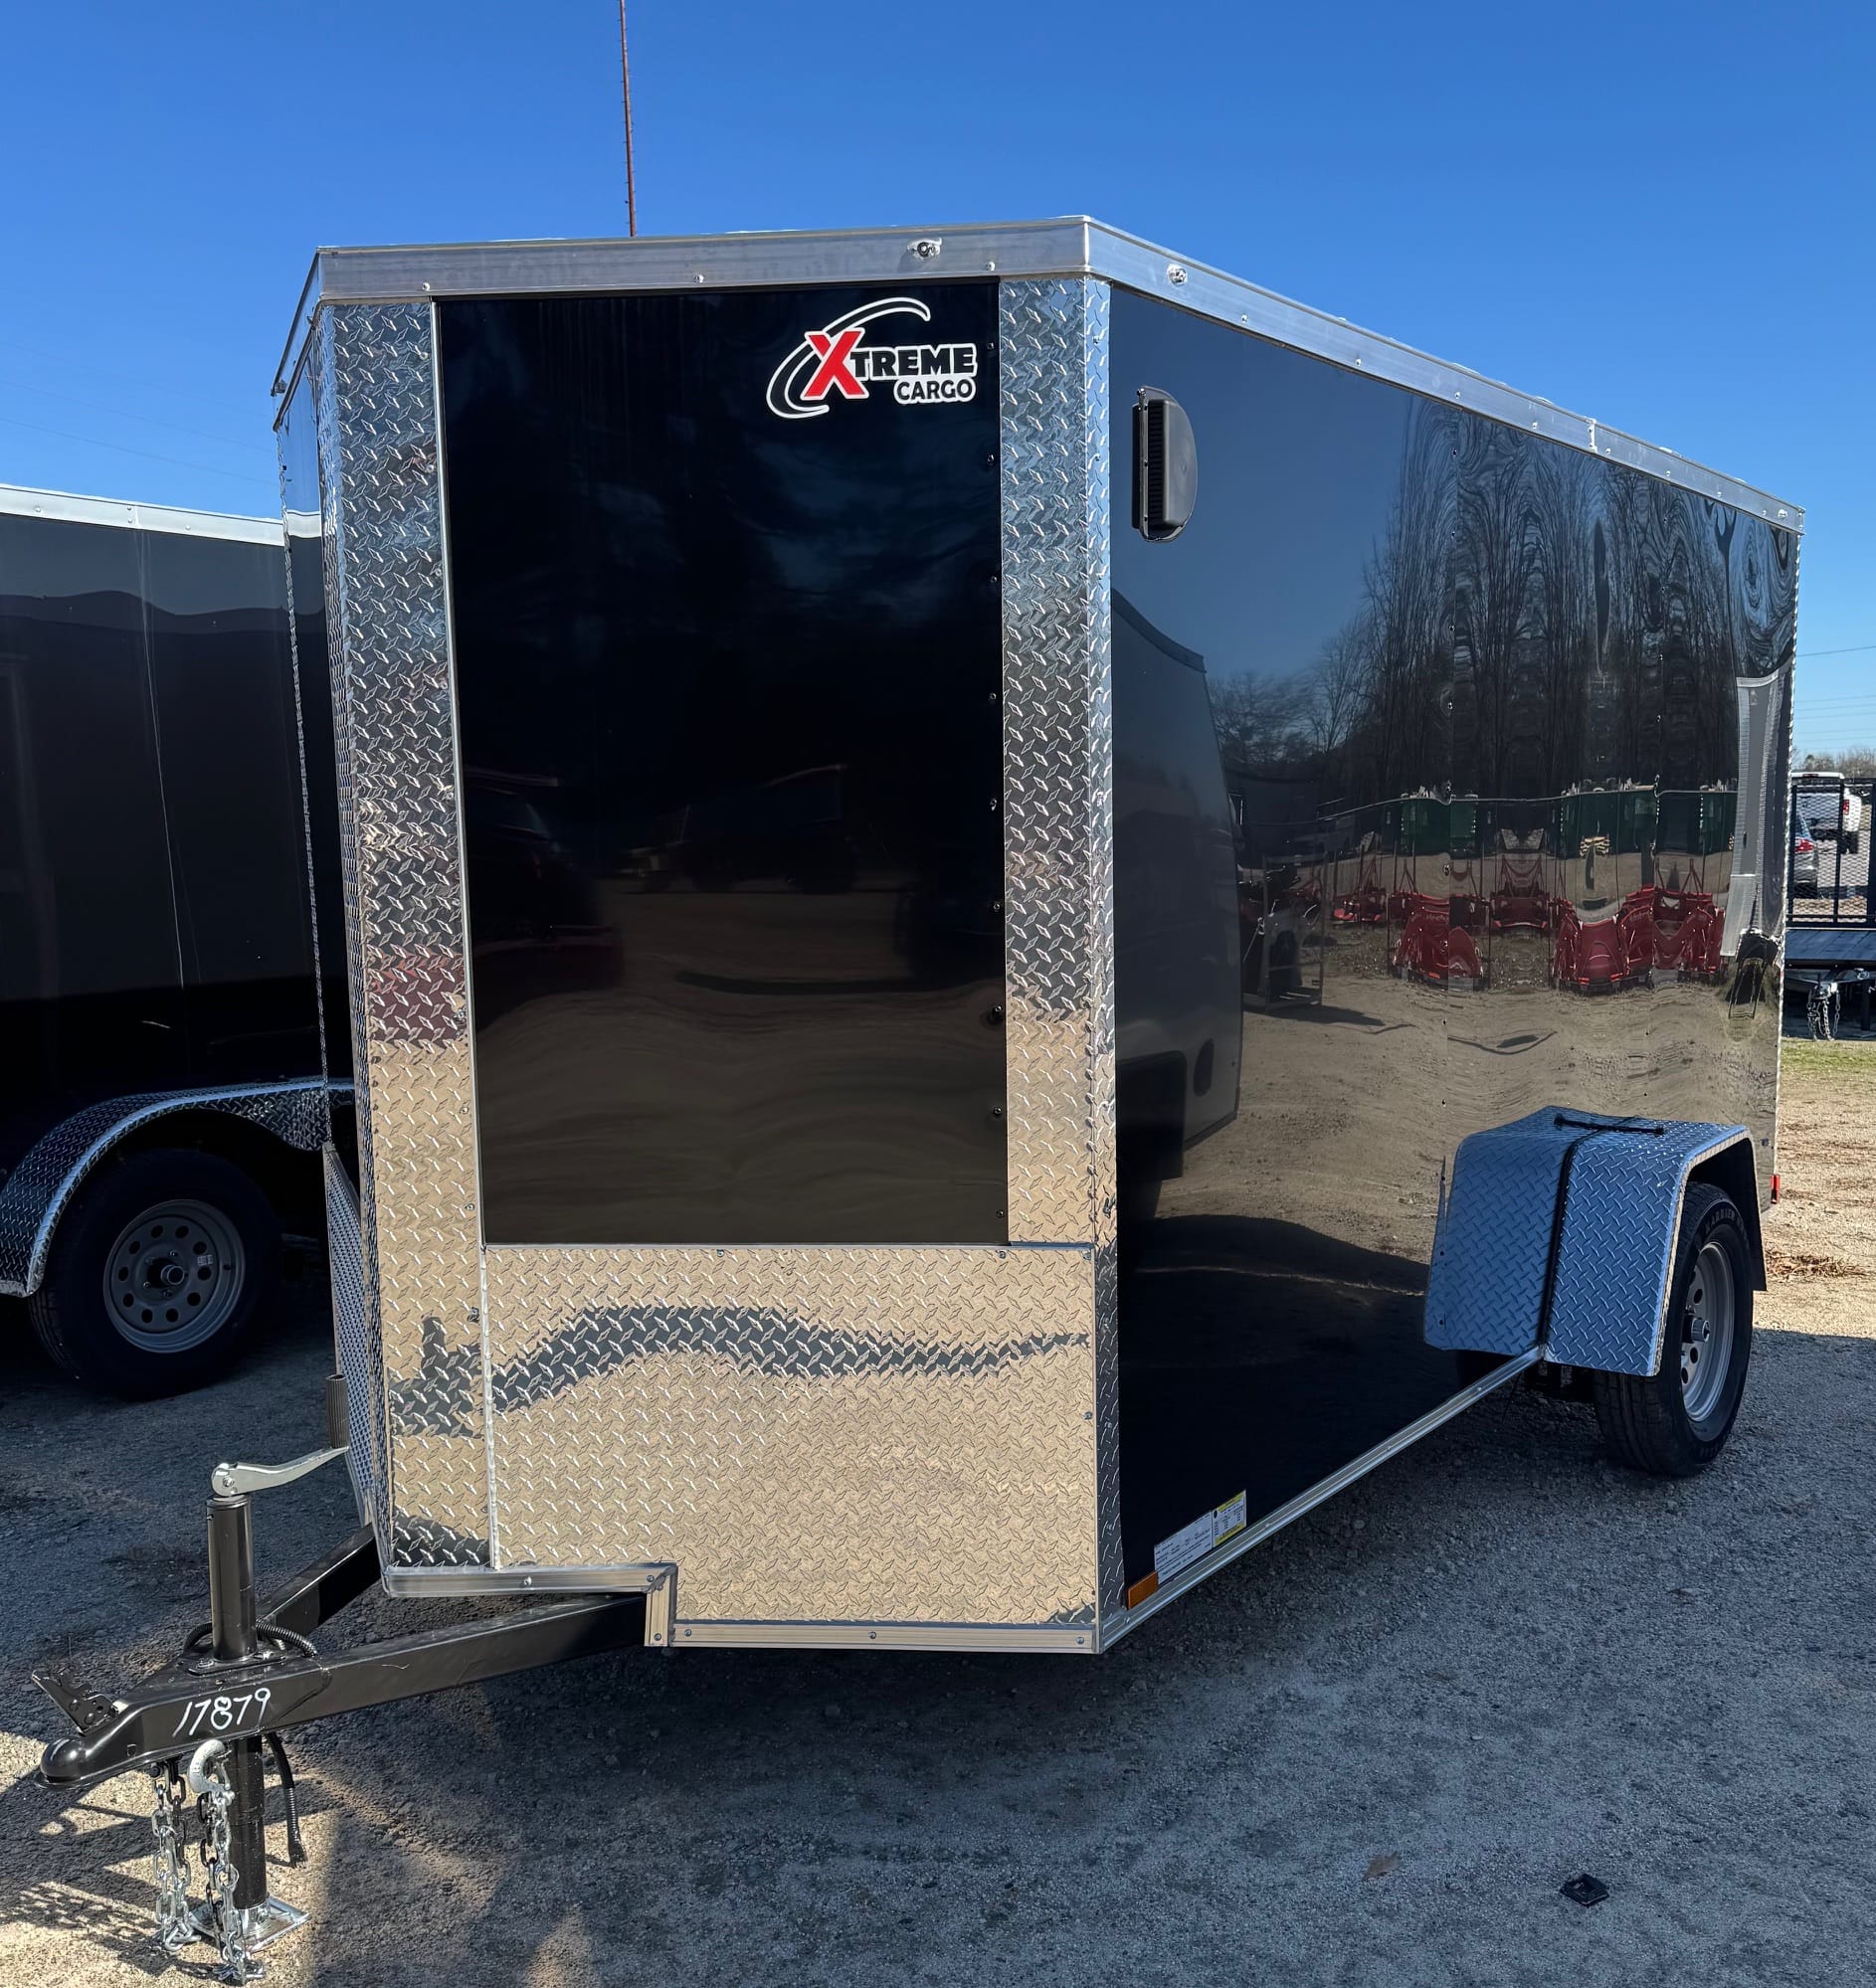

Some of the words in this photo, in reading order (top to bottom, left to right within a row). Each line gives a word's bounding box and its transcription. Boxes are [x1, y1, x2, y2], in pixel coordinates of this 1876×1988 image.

[801, 328, 976, 399] XTREME
[895, 378, 975, 403] CARGO
[171, 1687, 272, 1738] 17879
